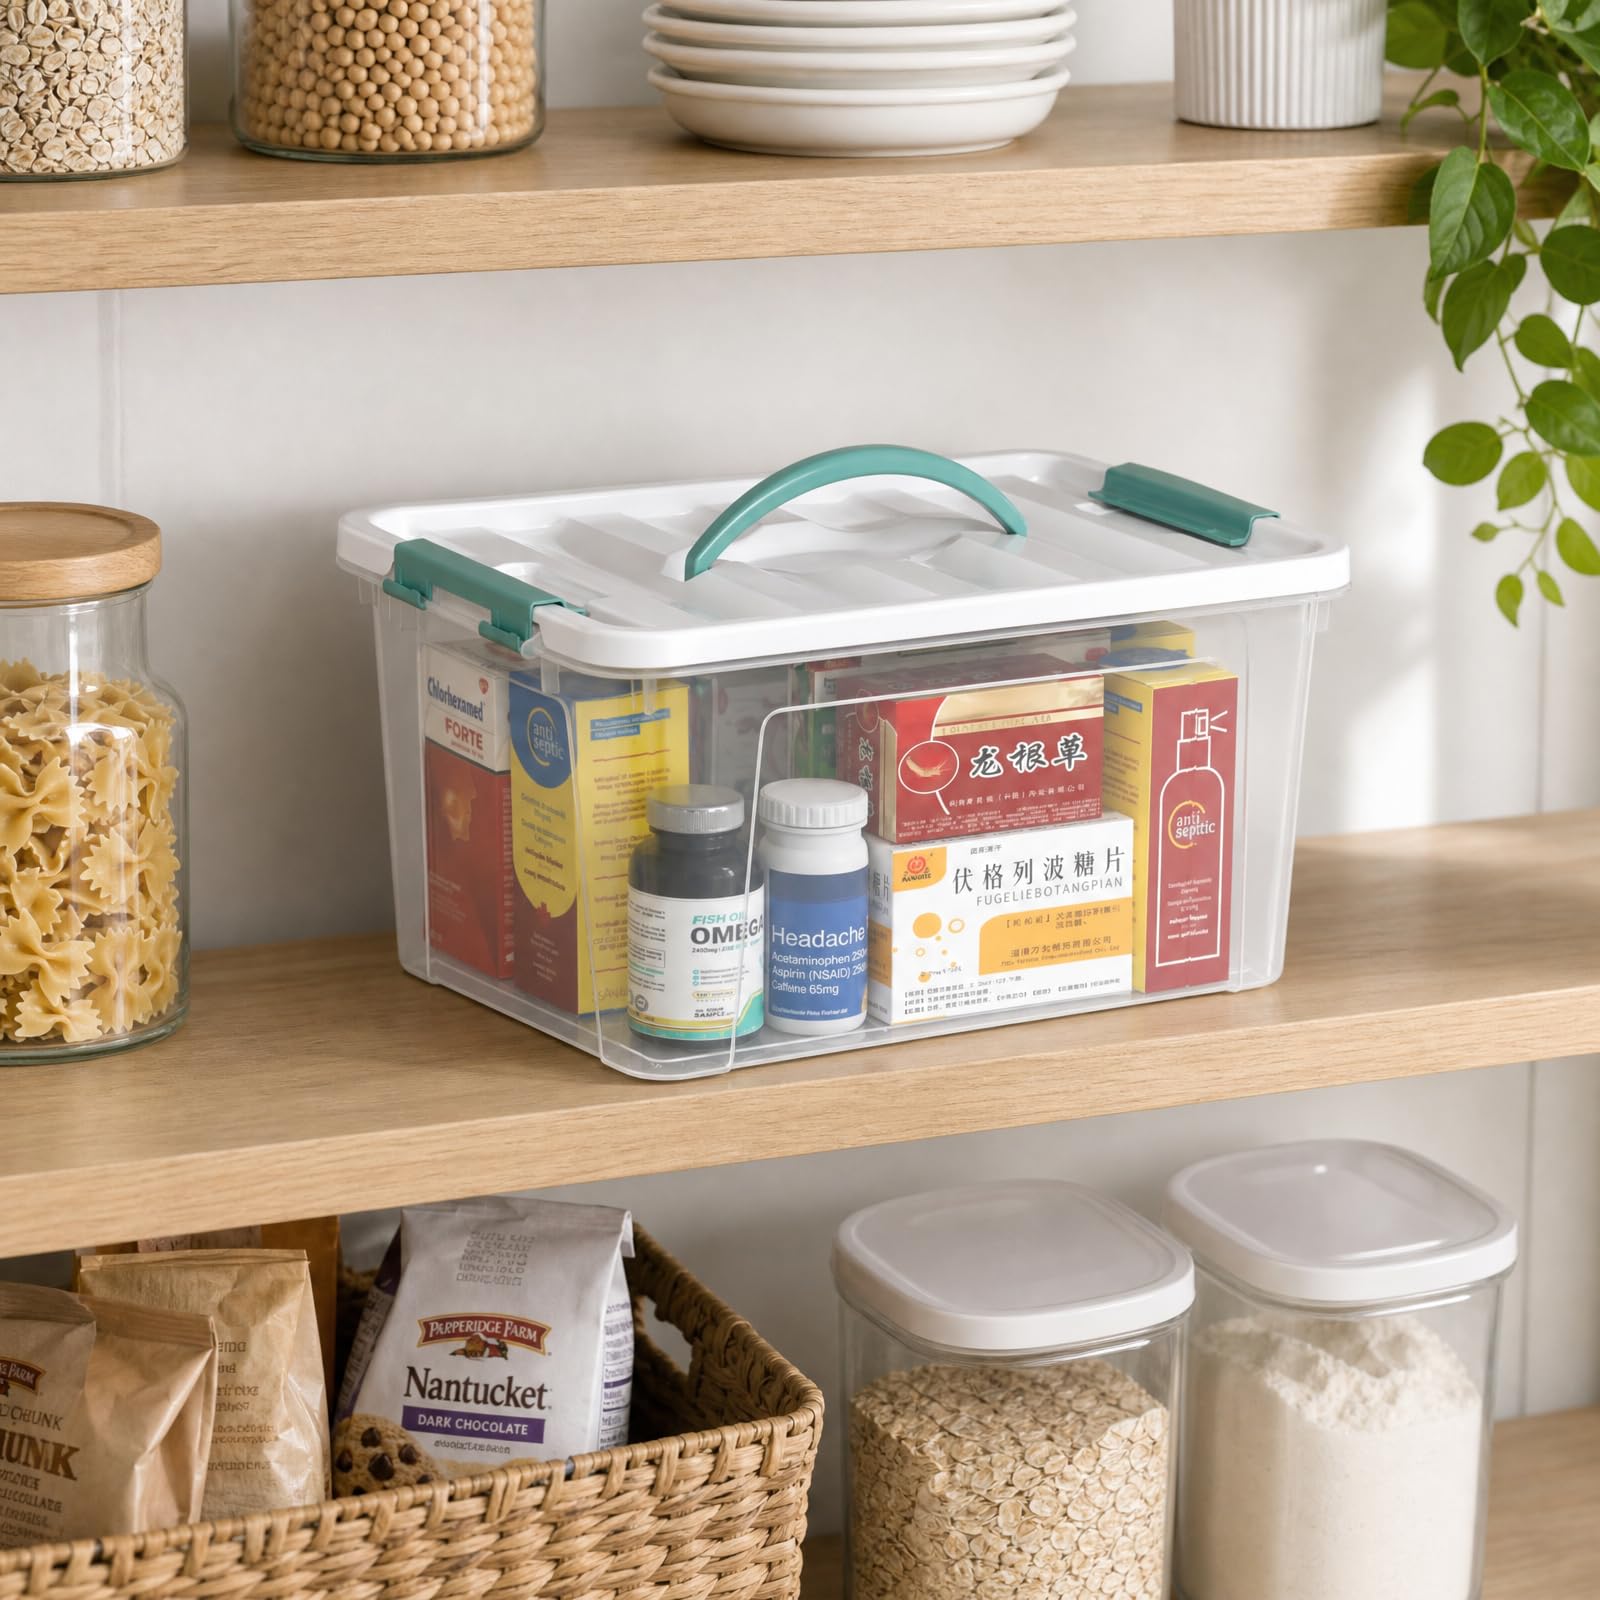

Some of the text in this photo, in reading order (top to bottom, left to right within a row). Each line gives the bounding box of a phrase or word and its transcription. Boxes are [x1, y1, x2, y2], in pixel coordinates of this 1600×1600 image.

[427, 677, 484, 721] Chlorhexamed
[444, 717, 484, 751] FORTE
[1176, 810, 1200, 827] anti
[952, 846, 1126, 894] 伏格列波糖片
[976, 877, 1123, 907] FUGELIEBOTANGPIAN
[692, 914, 725, 925] FISH
[772, 924, 865, 948] Headache
[772, 951, 850, 967] Acetaminophen
[772, 965, 806, 979] Aspirin
[808, 967, 851, 981] (NSAID)
[809, 984, 839, 996] 65mg
[503, 1320, 537, 1342] FARM
[403, 1366, 548, 1410] Nantucket
[417, 1414, 530, 1435] DARK CHOCOLATE
